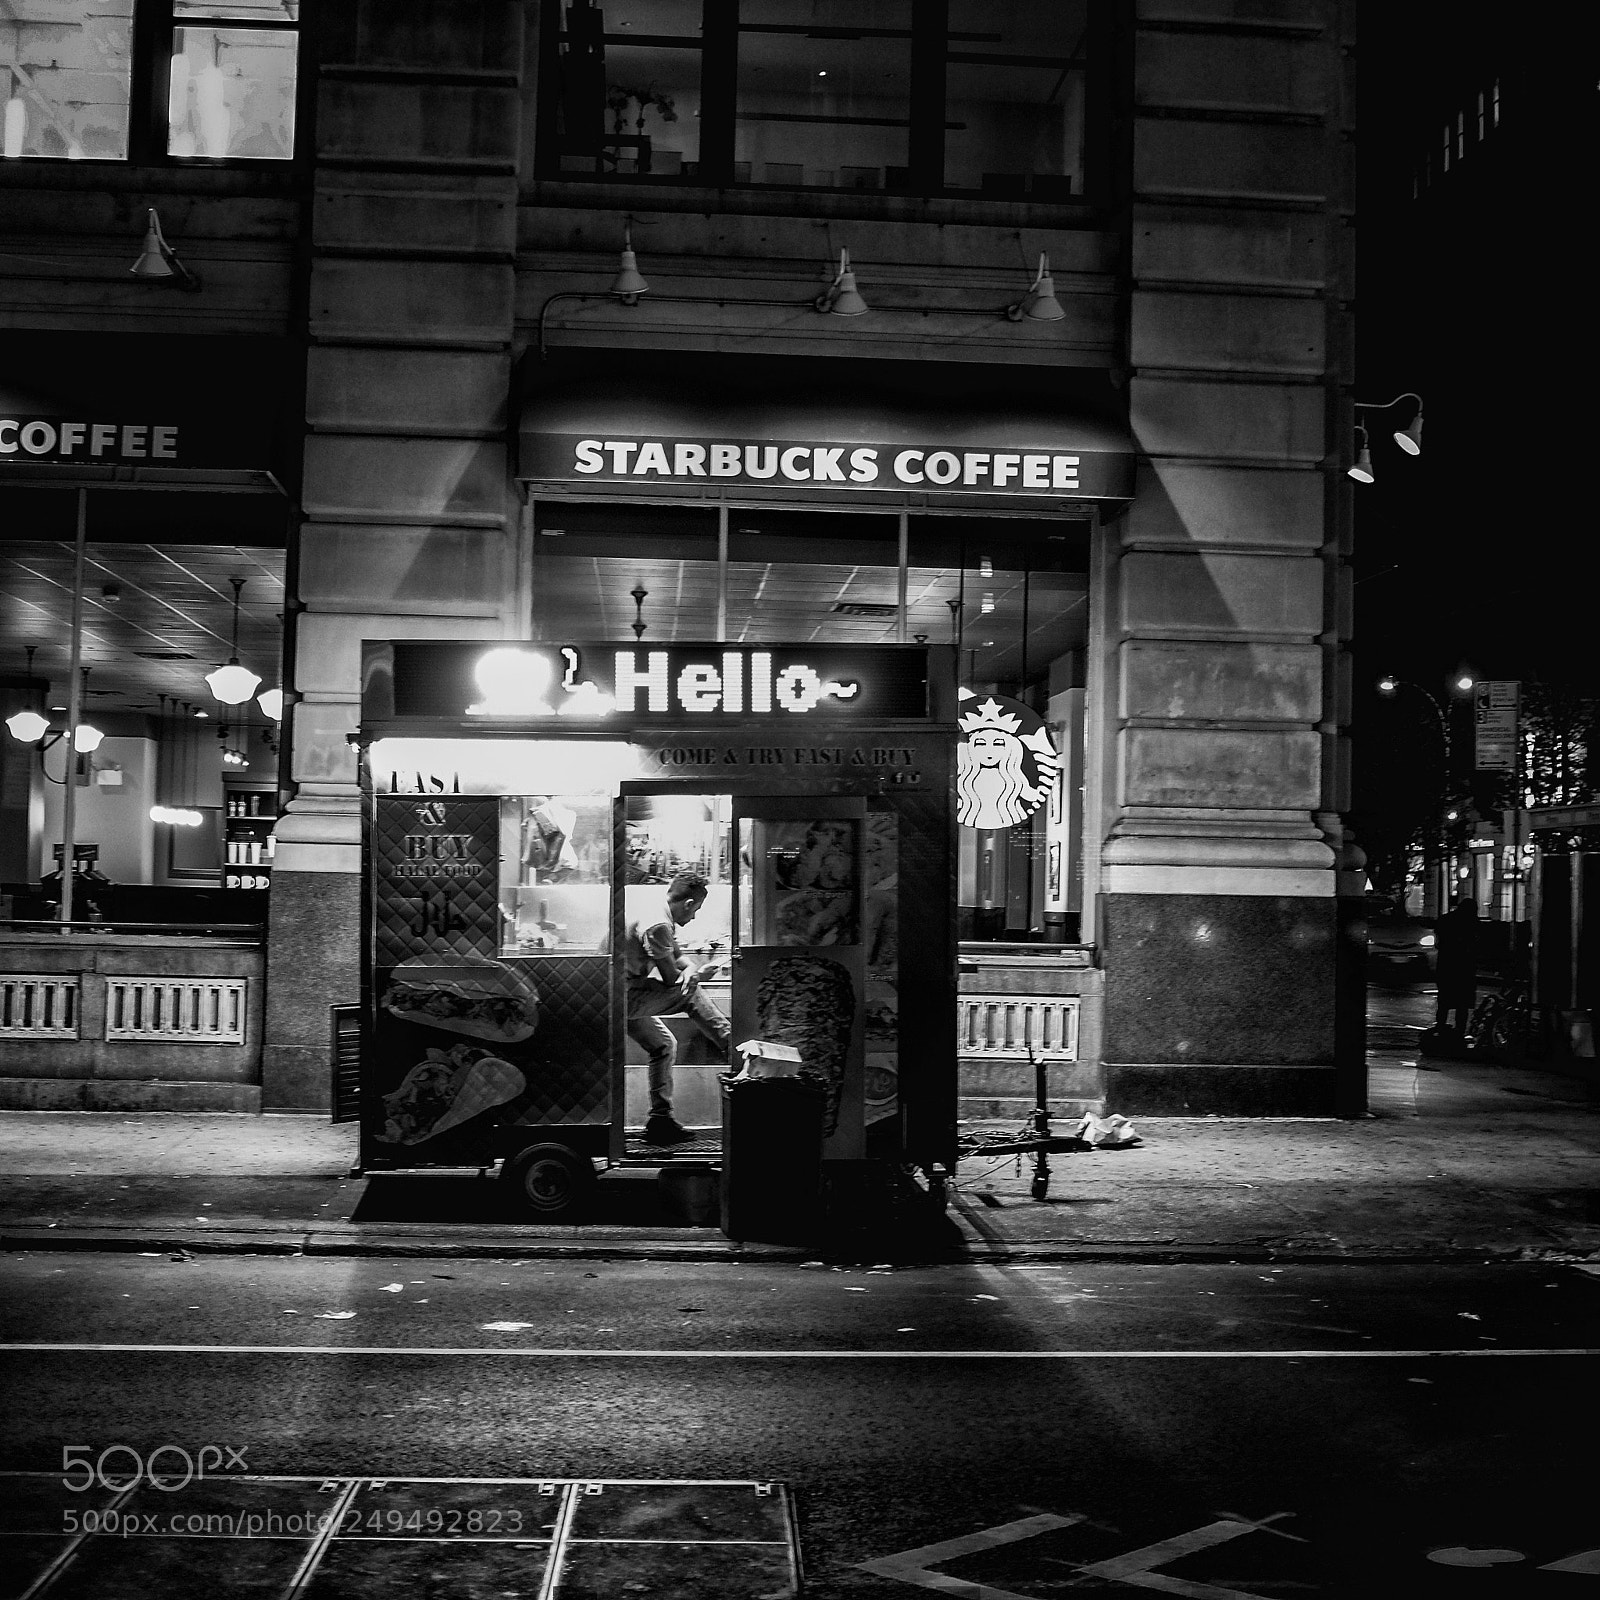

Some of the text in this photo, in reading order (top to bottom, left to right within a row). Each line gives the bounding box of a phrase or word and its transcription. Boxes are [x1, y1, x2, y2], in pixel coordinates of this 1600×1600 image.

[0, 419, 179, 458] COFFEE
[574, 440, 1080, 489] STARBUCKS COFFEE
[659, 749, 915, 766] COME & TRY FAST & BUY
[415, 801, 446, 825] &
[404, 835, 474, 861] BUY
